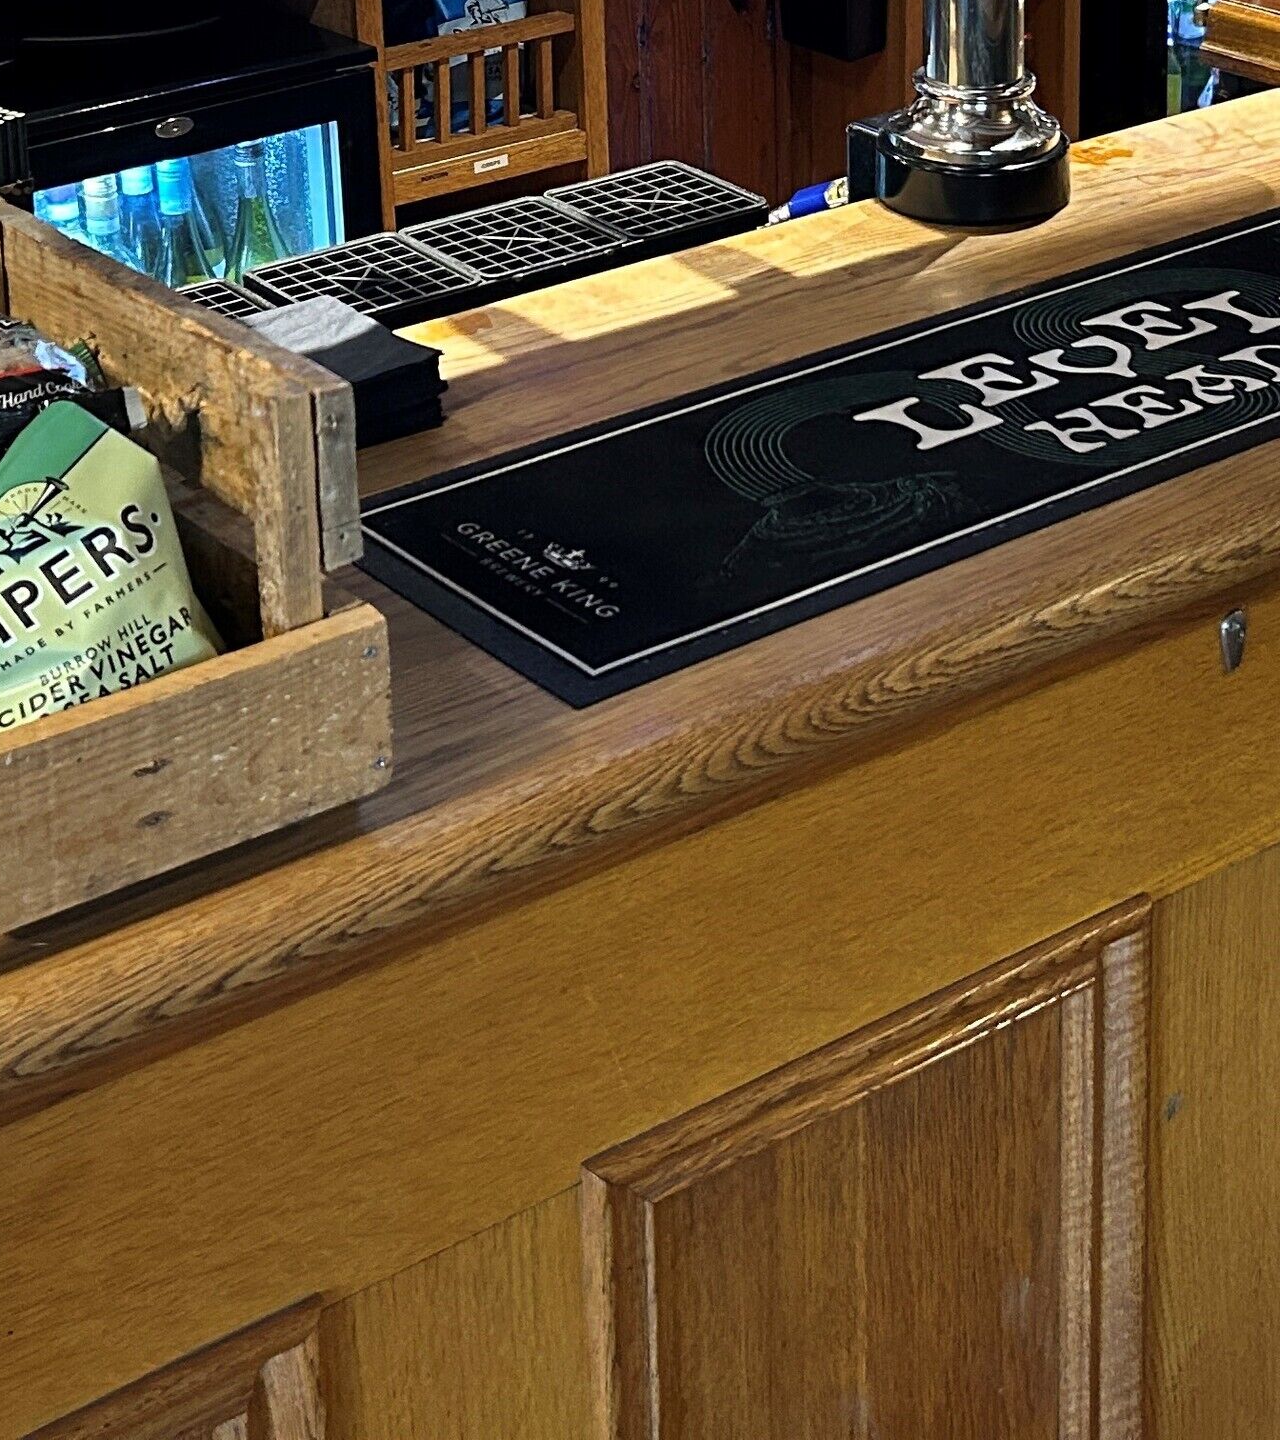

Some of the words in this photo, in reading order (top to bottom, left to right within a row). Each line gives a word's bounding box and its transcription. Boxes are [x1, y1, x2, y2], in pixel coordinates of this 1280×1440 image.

[455, 519, 554, 584] GREENE
[553, 571, 621, 620] KING
[0, 638, 47, 672] MADE
[56, 620, 75, 638] BY
[83, 572, 152, 618] FARMERS
[40, 639, 113, 687] BURROW
[118, 613, 152, 640] HILL
[89, 606, 192, 681] VINEGAR
[118, 642, 176, 691] SALT
